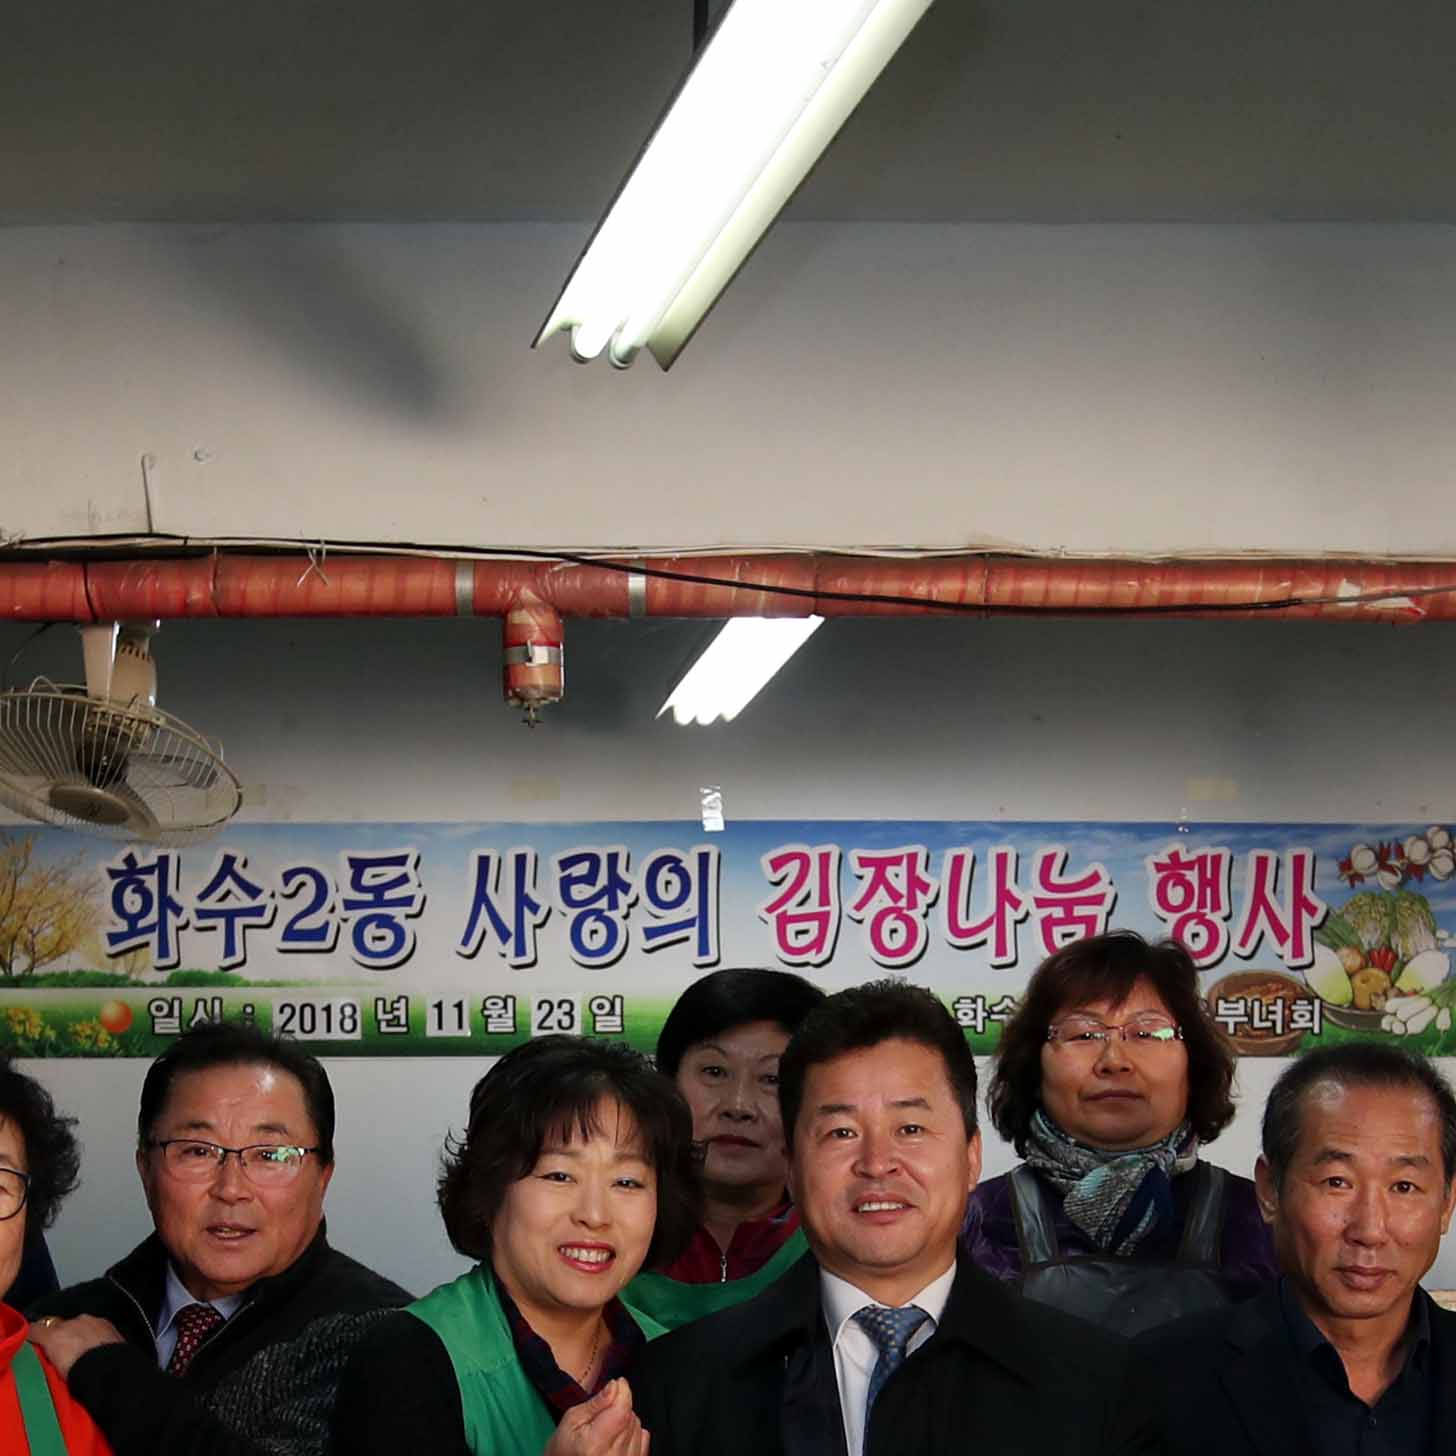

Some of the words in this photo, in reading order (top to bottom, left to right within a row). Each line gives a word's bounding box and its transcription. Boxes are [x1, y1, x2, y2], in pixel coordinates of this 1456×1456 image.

[104, 849, 422, 964] 화수2동
[456, 848, 715, 964] 사랑의
[761, 848, 1112, 963] 김장나눔
[1150, 846, 1325, 966] 행사
[148, 996, 224, 1036] 일시
[278, 1002, 359, 1035] 2018
[375, 995, 410, 1035] 년
[432, 999, 464, 1031] 11
[480, 994, 517, 1035] 월
[536, 998, 575, 1032] 23
[588, 994, 625, 1034] 일
[1214, 997, 1323, 1036] 부녀회
